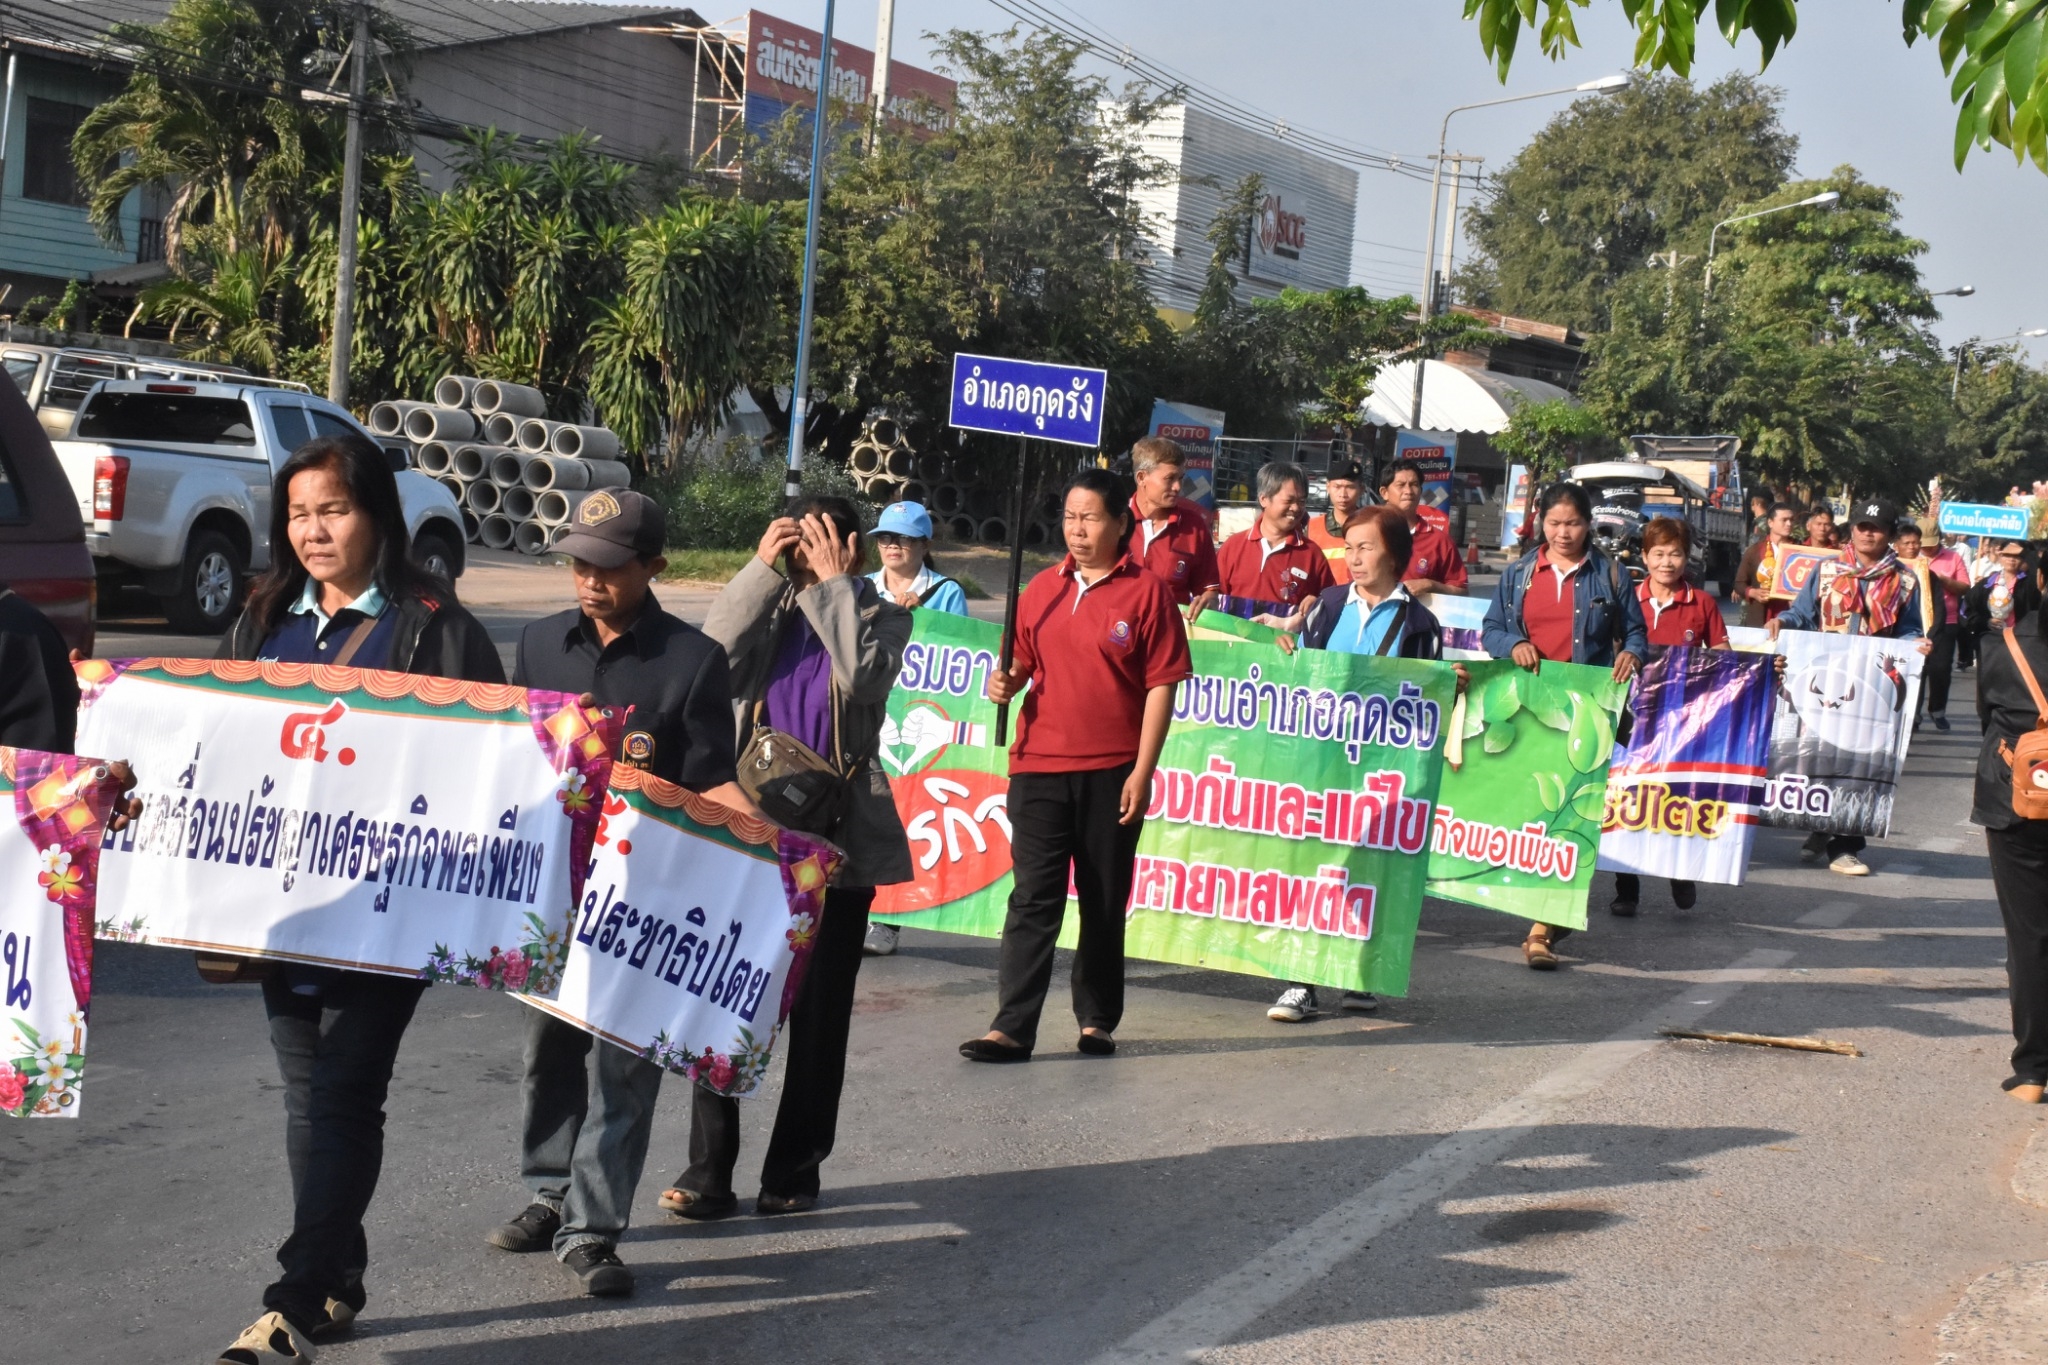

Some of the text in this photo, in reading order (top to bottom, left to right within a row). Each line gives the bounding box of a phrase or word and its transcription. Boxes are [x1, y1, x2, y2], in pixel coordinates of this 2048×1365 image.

[963, 365, 1093, 430] อำเภอกุดรัง
[1162, 426, 1206, 439] COTTO
[1405, 449, 1440, 458] COTTO
[1943, 509, 2023, 535] อำเภอโกสุมพิสัย
[1125, 866, 1377, 940] หายาเสพติด
